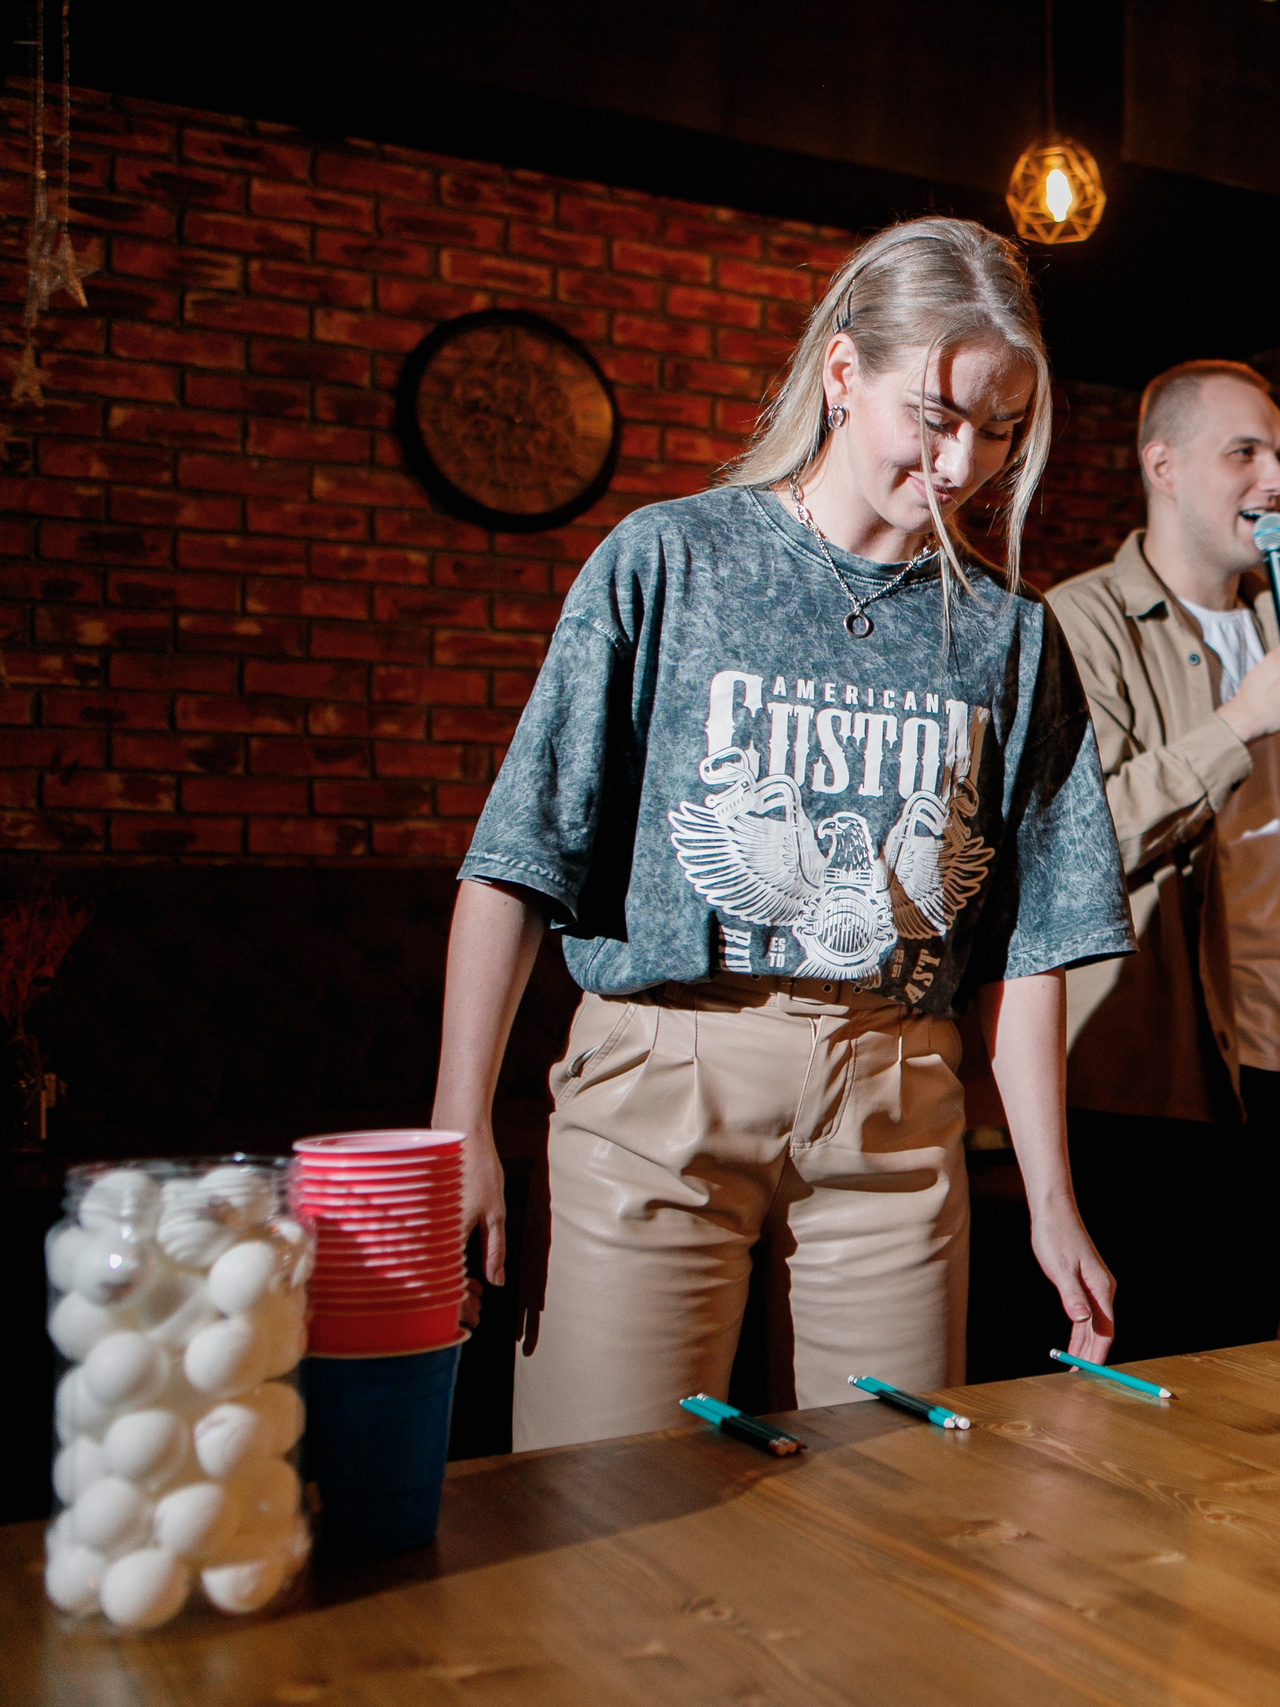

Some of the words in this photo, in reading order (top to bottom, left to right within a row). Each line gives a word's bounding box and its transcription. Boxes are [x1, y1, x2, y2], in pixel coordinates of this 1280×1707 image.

[773, 676, 940, 714] AMERICAN
[770, 936, 786, 951] ES
[768, 953, 785, 968] TD
